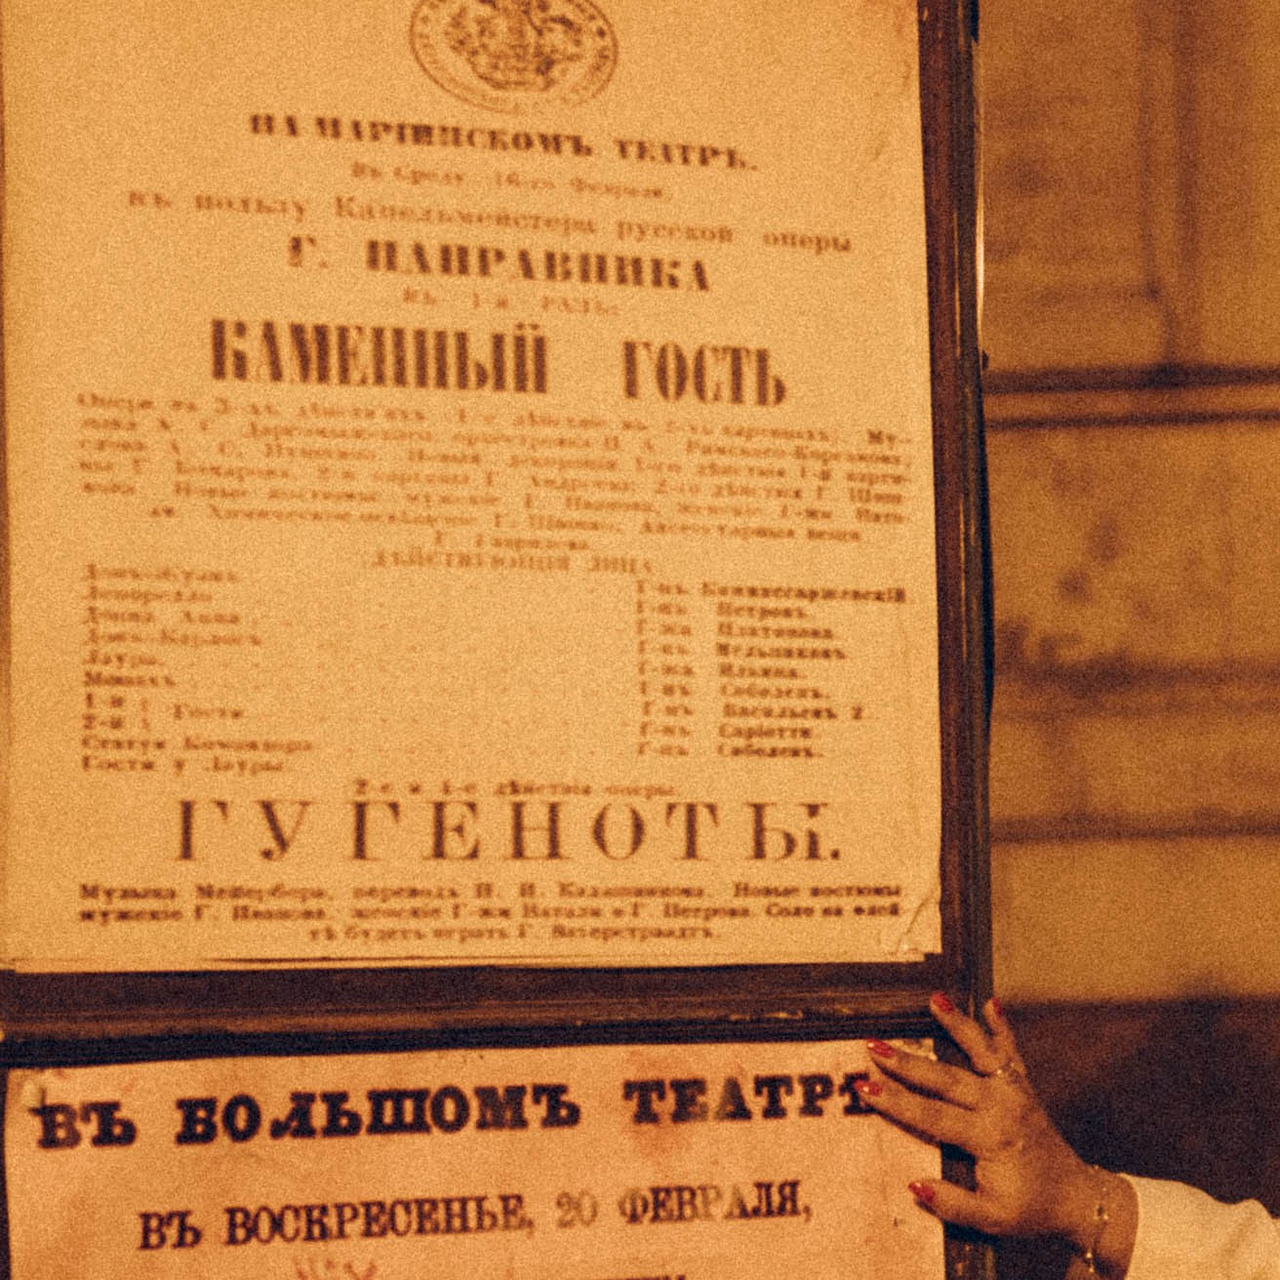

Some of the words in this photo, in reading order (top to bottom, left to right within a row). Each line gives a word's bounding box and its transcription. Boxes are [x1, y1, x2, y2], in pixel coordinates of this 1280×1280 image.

[210, 317, 549, 395] КАМЕННЫЙ
[622, 338, 789, 408] ГОСТЬ
[173, 798, 843, 862] ГУГЕНОТЫ.
[37, 1099, 138, 1150] ВЪ
[173, 1082, 583, 1146] БОЛЬШОМЪ
[138, 1209, 203, 1251] ВЪ
[223, 1192, 534, 1247] ВОСКРЕСЕНЬЕ,
[555, 1189, 600, 1229] 20
[617, 1179, 813, 1226] ФЕВРАЛЯ,
